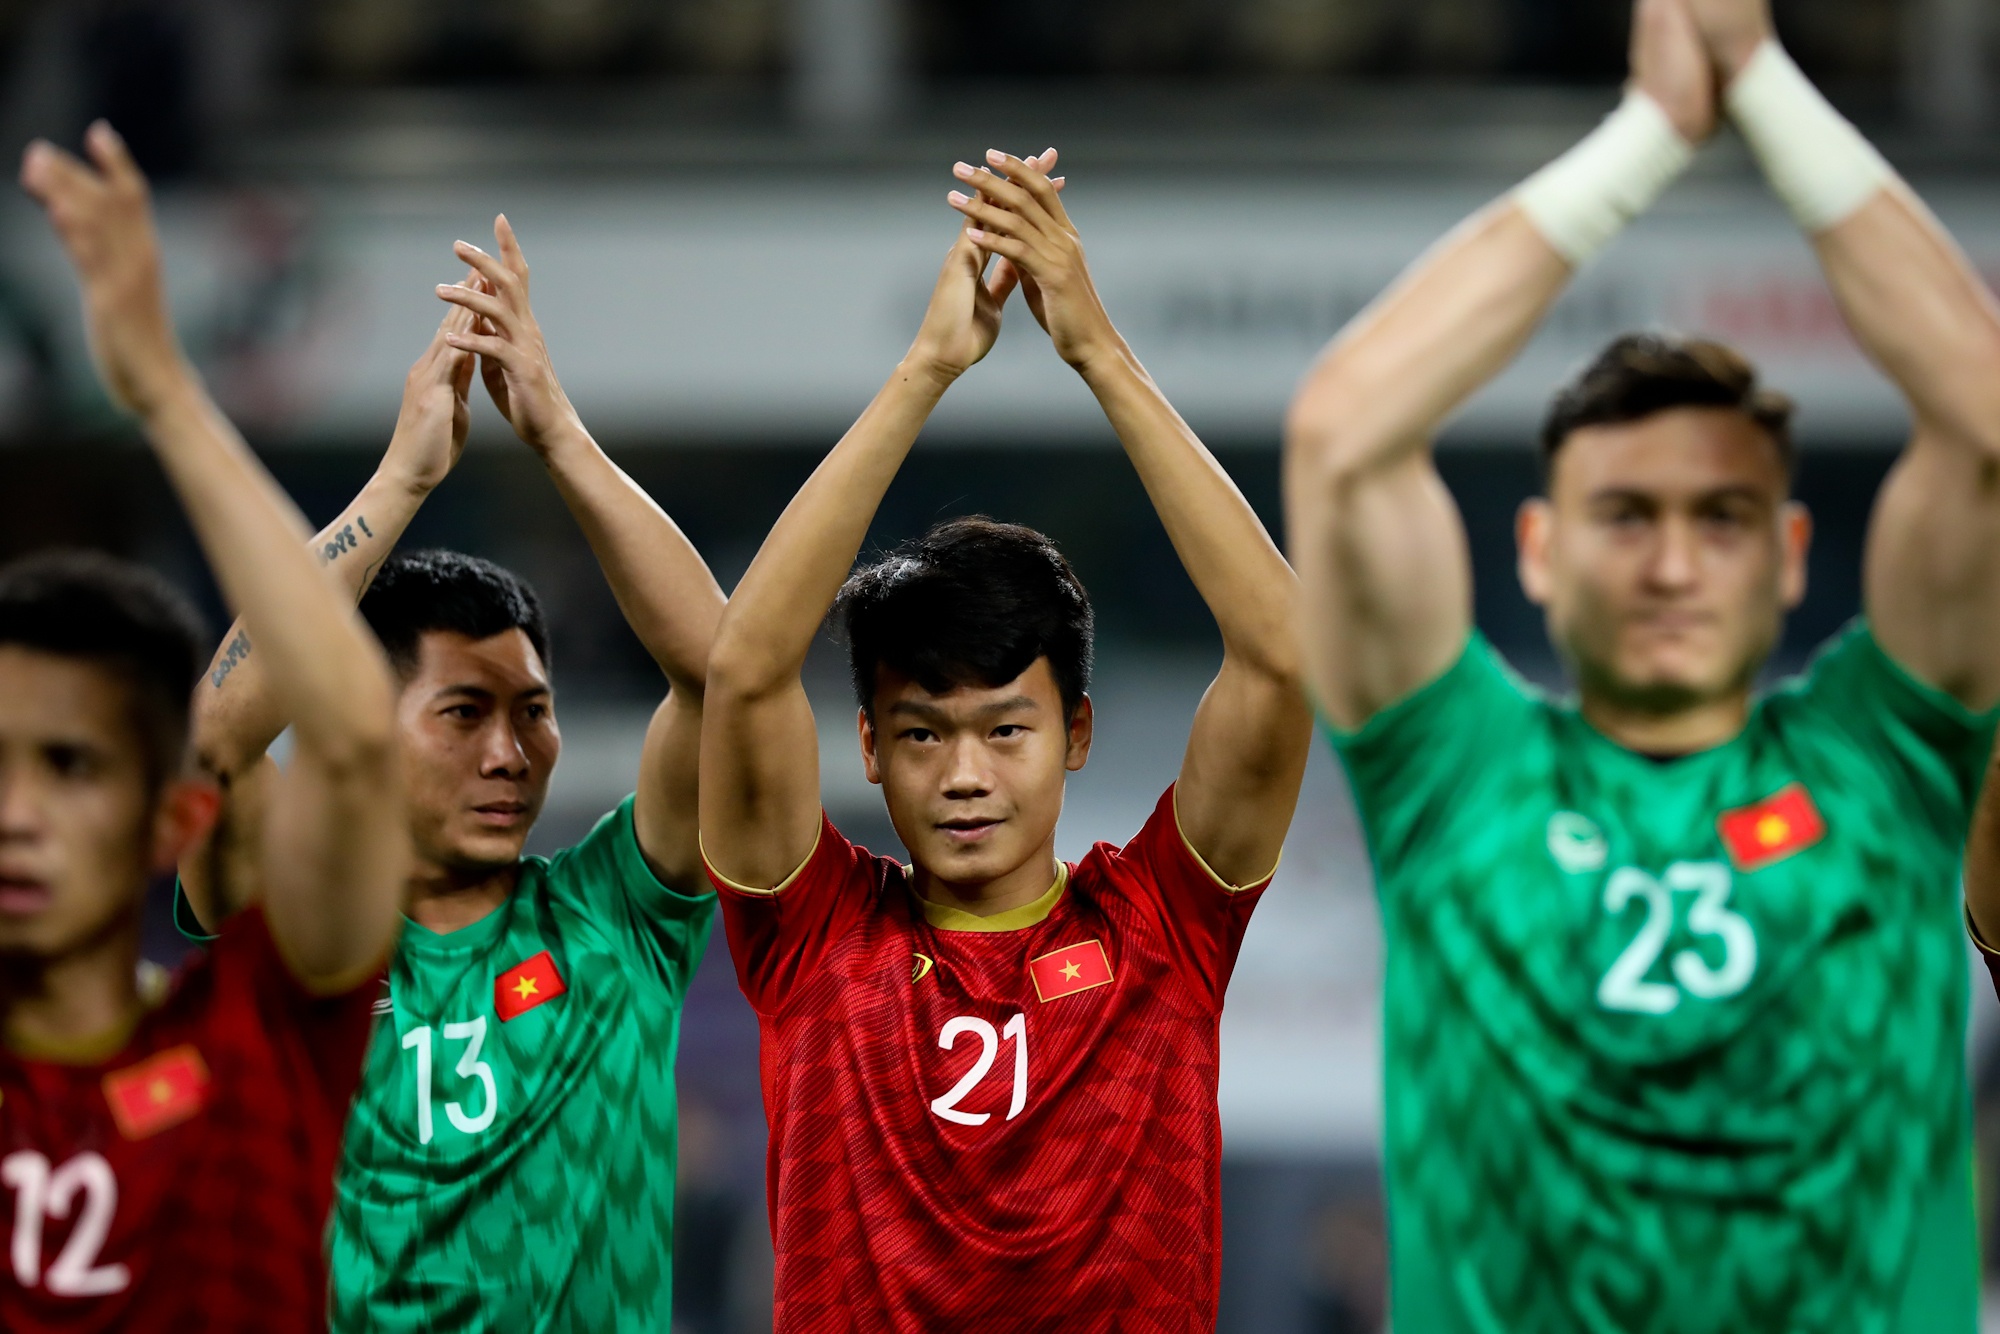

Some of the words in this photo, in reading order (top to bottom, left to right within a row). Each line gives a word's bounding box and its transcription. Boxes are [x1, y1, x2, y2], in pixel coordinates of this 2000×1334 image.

[1598, 861, 1757, 1015] 23
[402, 1015, 498, 1145] 13
[931, 1013, 1028, 1126] 21
[1, 1150, 130, 1296] 12
